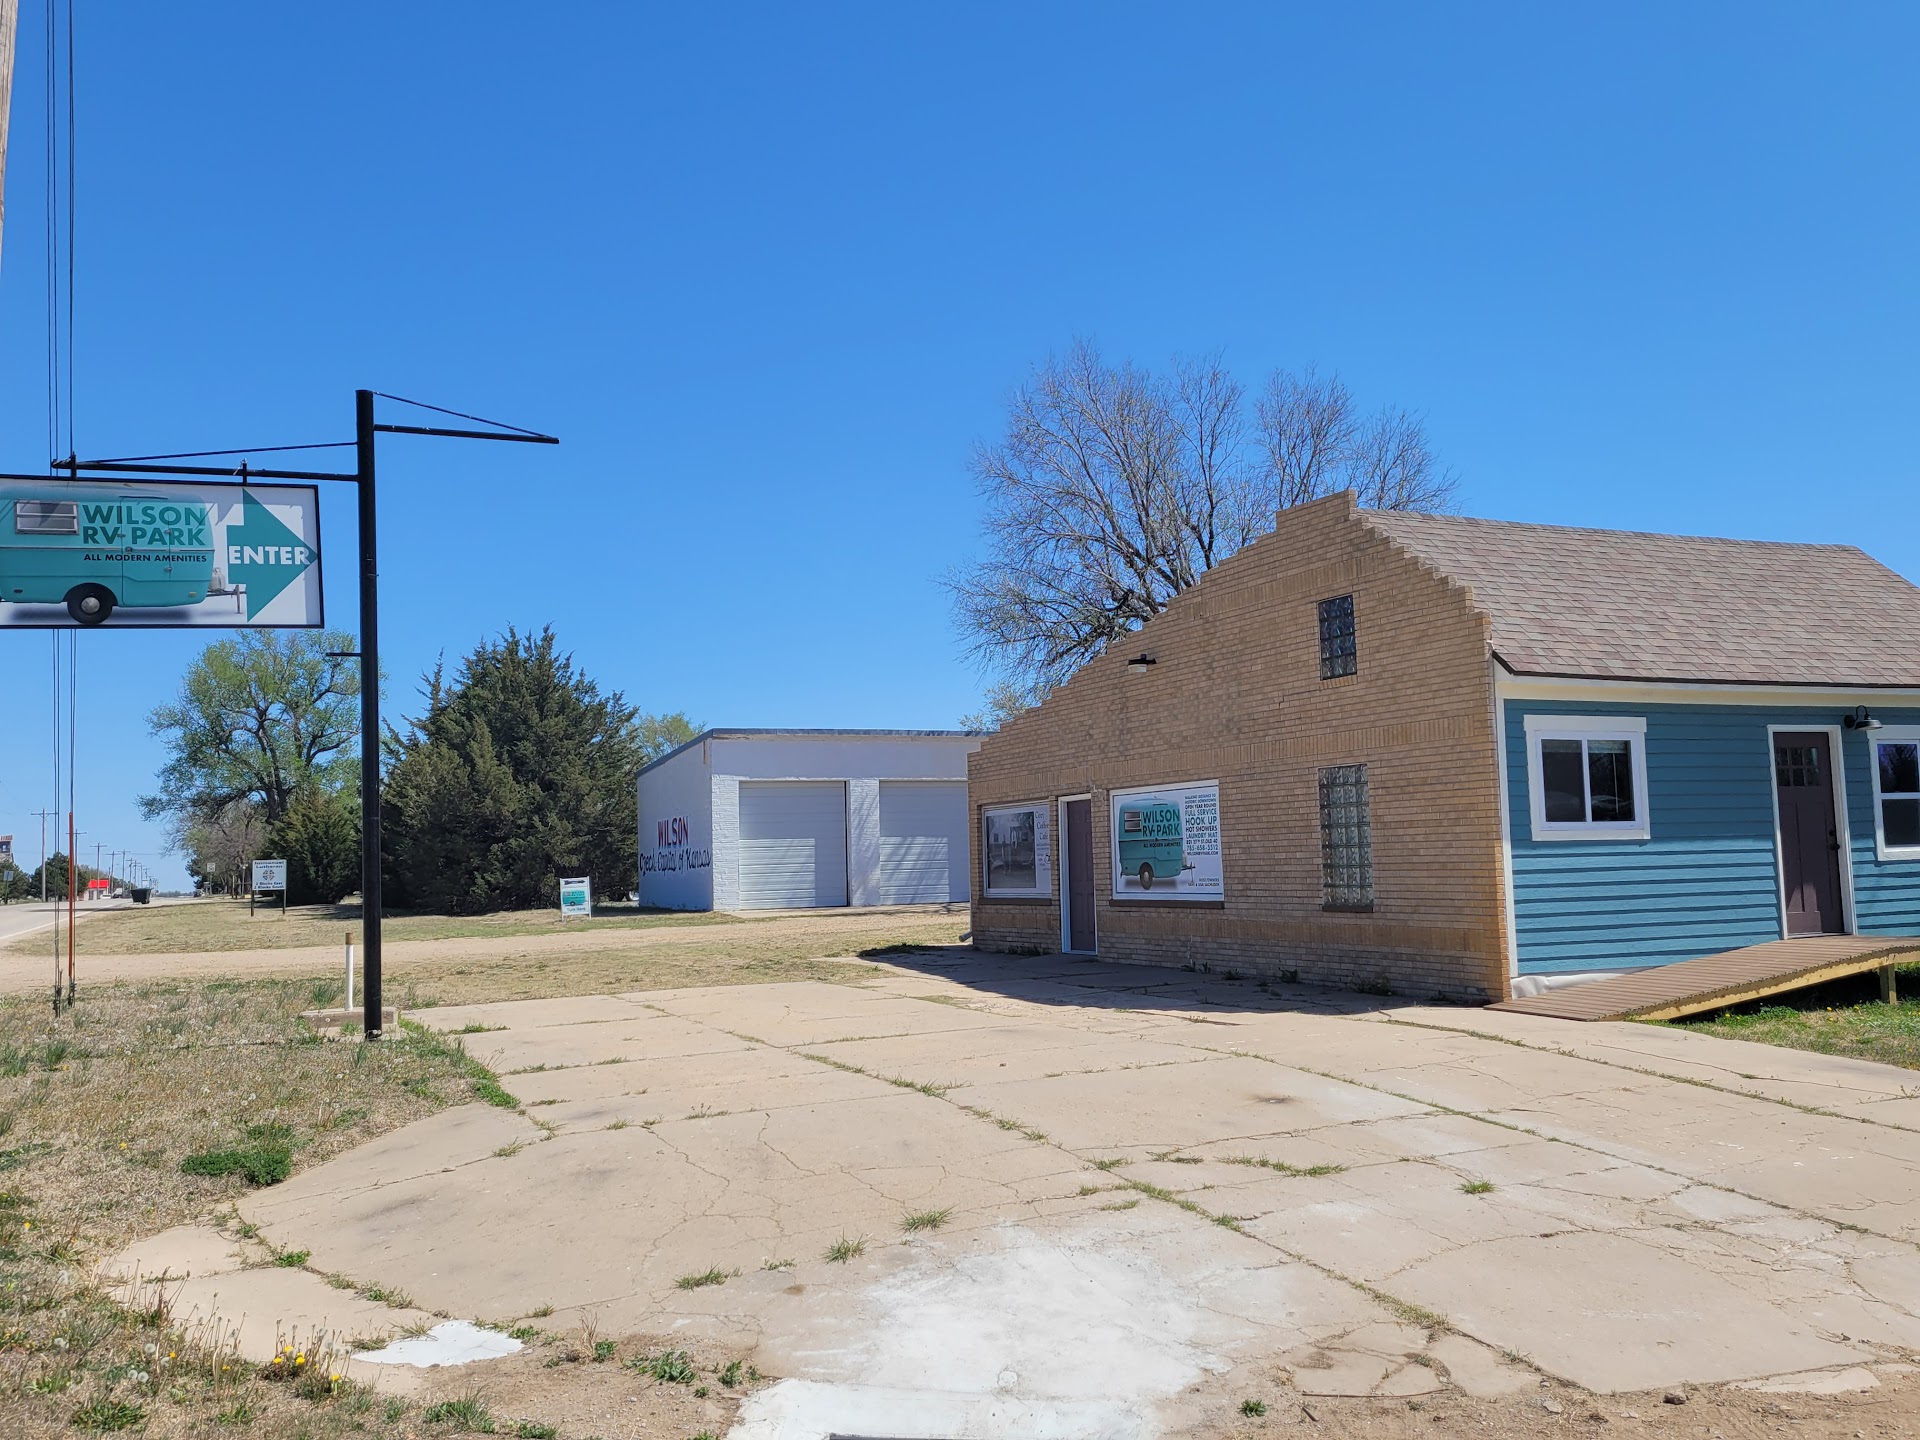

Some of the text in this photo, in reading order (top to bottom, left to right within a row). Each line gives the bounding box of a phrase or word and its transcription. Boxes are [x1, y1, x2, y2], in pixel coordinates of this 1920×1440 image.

[82, 504, 206, 526] WILSON
[83, 526, 206, 546] RV PARK
[84, 553, 207, 563] ALL MODERN AMENITIES
[229, 545, 311, 565] ENTER
[1142, 809, 1180, 823] WILSON
[1185, 816, 1218, 826] HOOK UP
[658, 816, 688, 848] WILSON
[1142, 823, 1180, 837] RV PARK
[685, 847, 711, 870] Kansas
